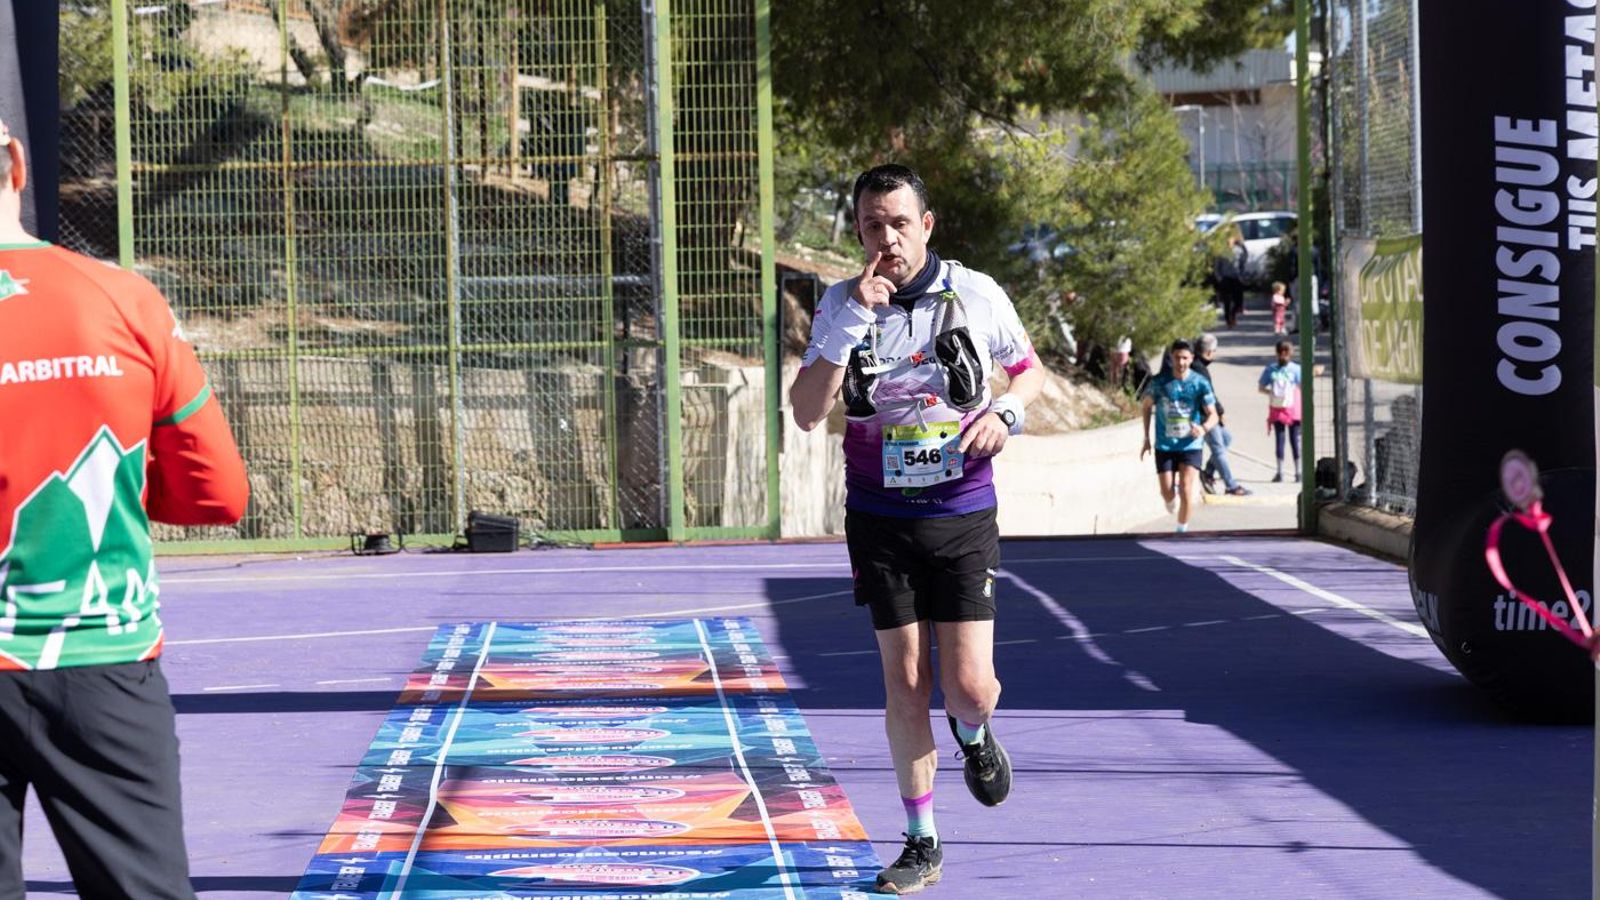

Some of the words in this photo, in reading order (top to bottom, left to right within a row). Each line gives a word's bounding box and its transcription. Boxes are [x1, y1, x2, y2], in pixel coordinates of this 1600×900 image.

[1564, 0, 1597, 160] META
[1495, 115, 1562, 396] CONSIGUE
[0, 355, 124, 384] ARBITRAL
[904, 448, 942, 466] 546
